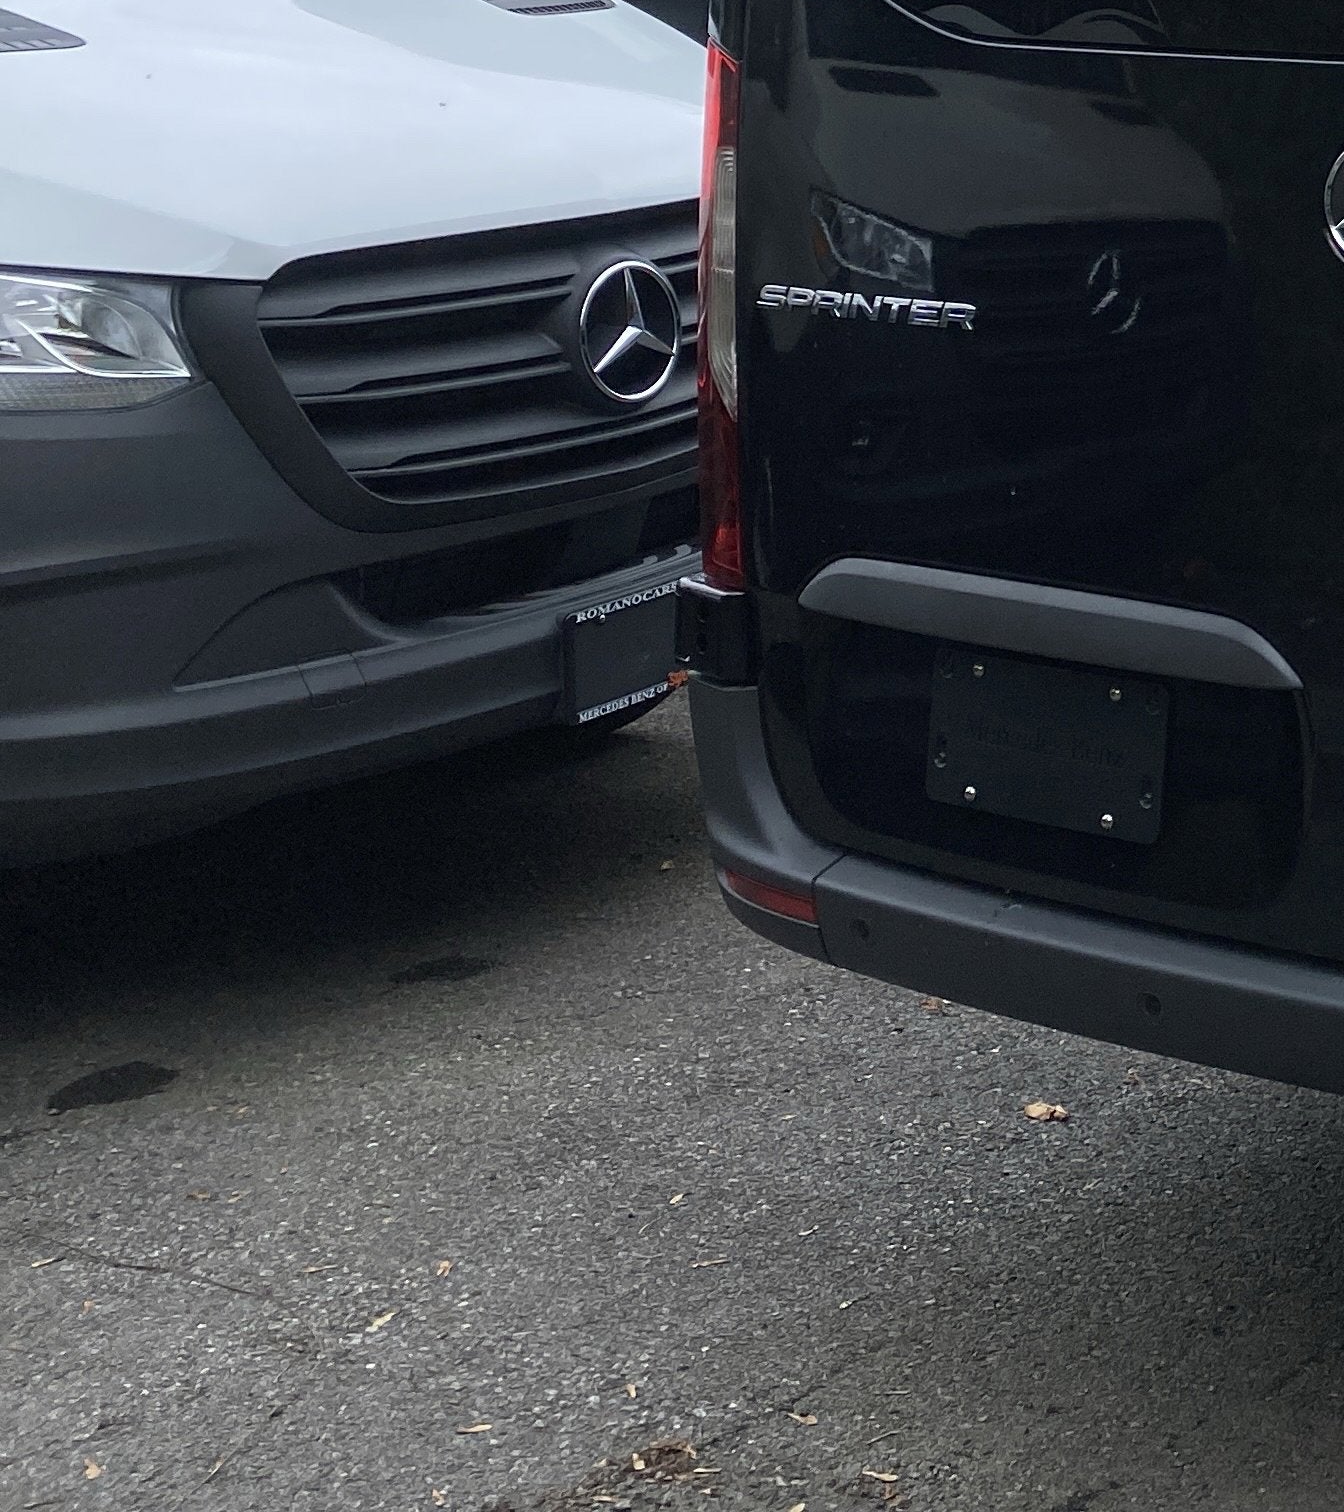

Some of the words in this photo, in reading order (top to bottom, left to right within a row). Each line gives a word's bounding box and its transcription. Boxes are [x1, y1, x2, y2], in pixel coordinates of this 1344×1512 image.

[756, 285, 976, 330] SPRINTER
[579, 691, 630, 723] MERCEDES
[631, 689, 655, 705] BENZ
